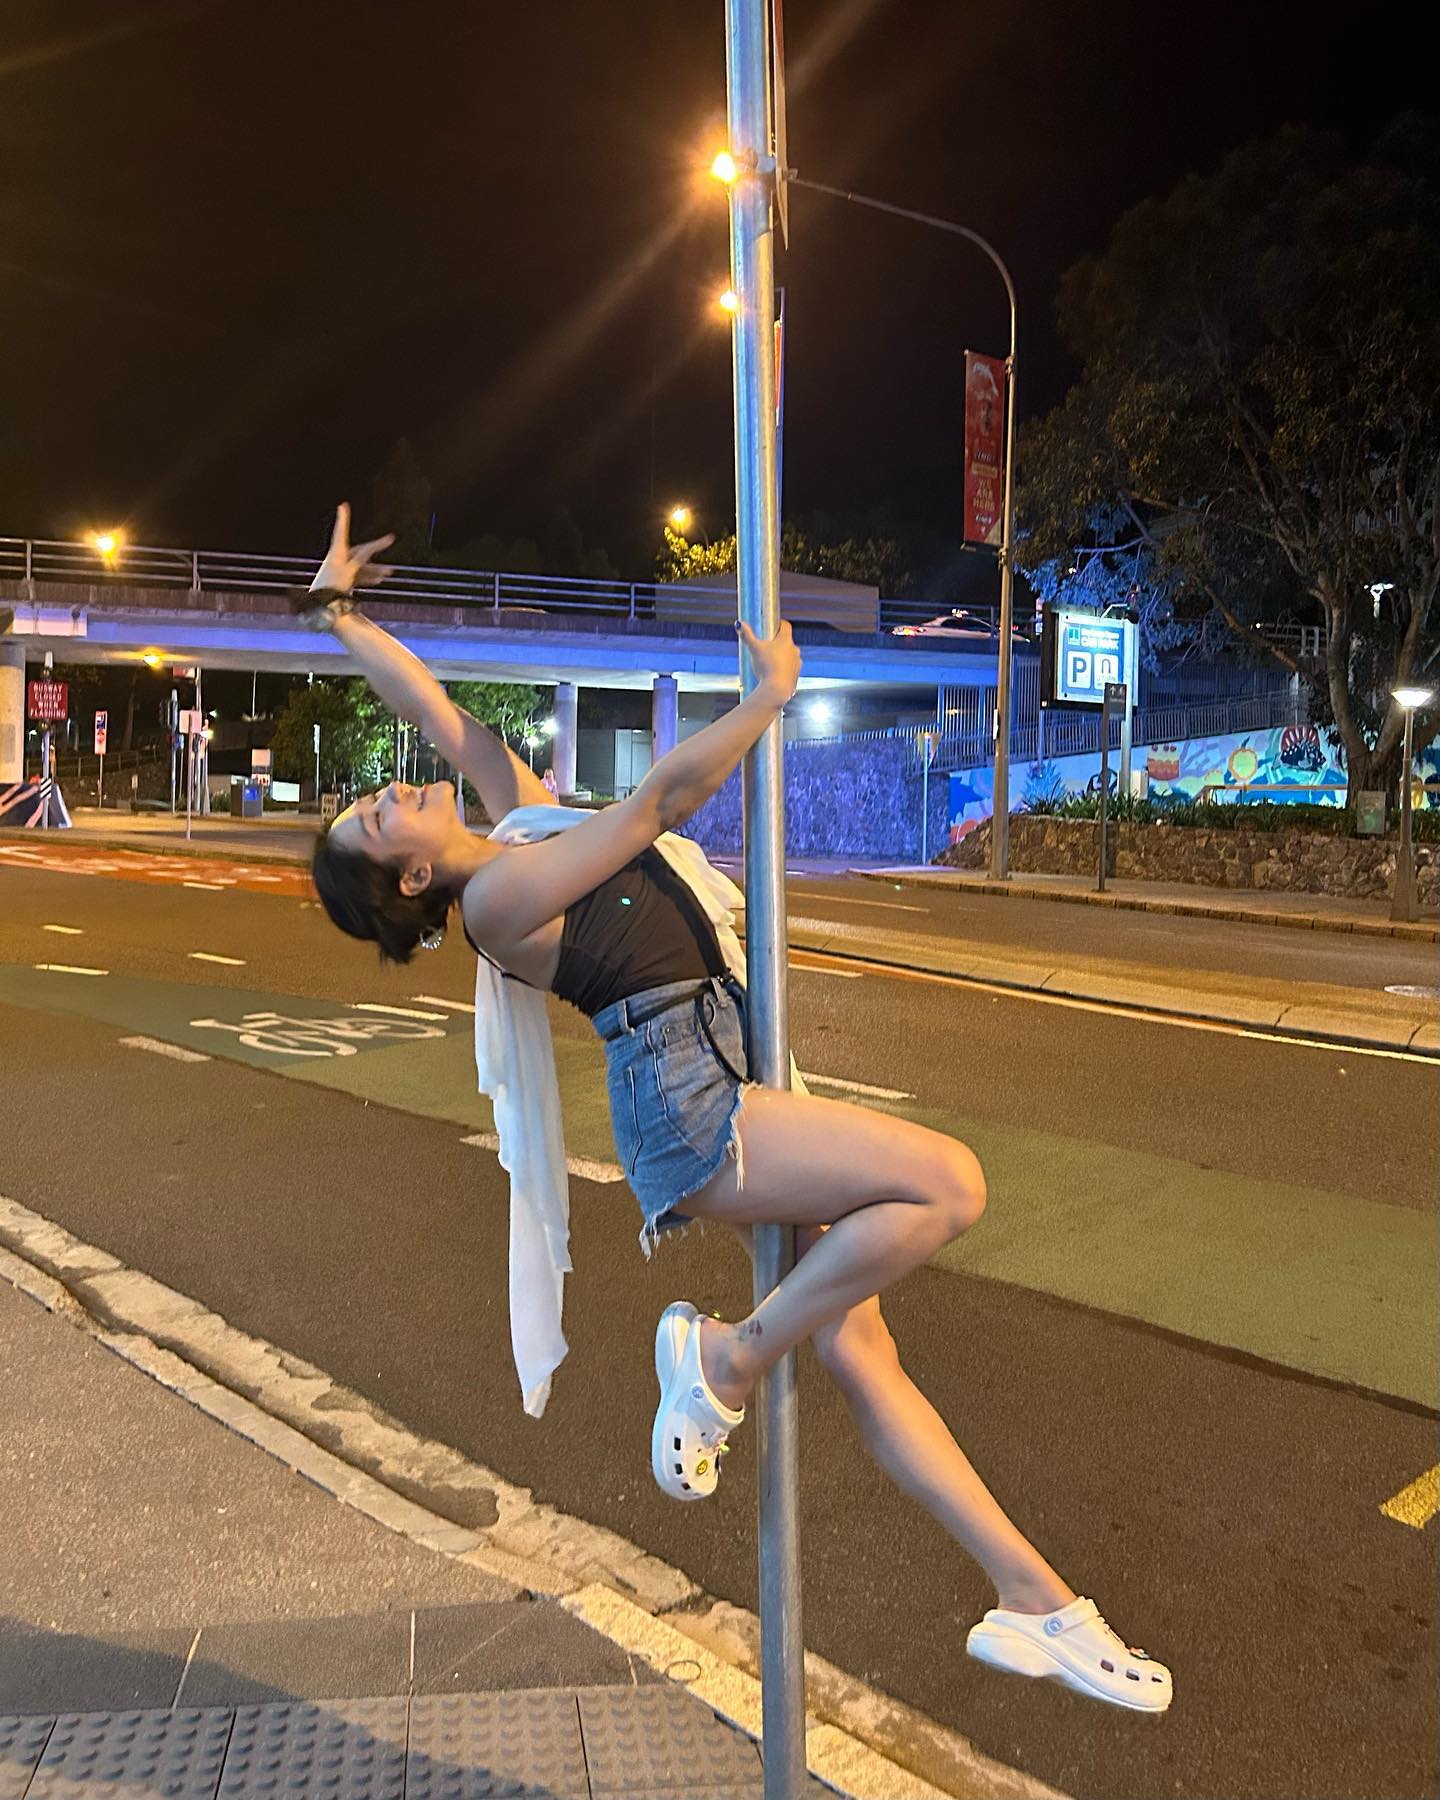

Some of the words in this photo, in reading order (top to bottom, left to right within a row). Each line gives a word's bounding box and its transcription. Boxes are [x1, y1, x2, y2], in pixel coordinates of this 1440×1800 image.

[1072, 656, 1087, 682] P
[33, 682, 63, 692] BUSWAY
[34, 692, 62, 701] CLOSED
[38, 701, 59, 709] WHEN
[30, 708, 66, 718] FLASHING
